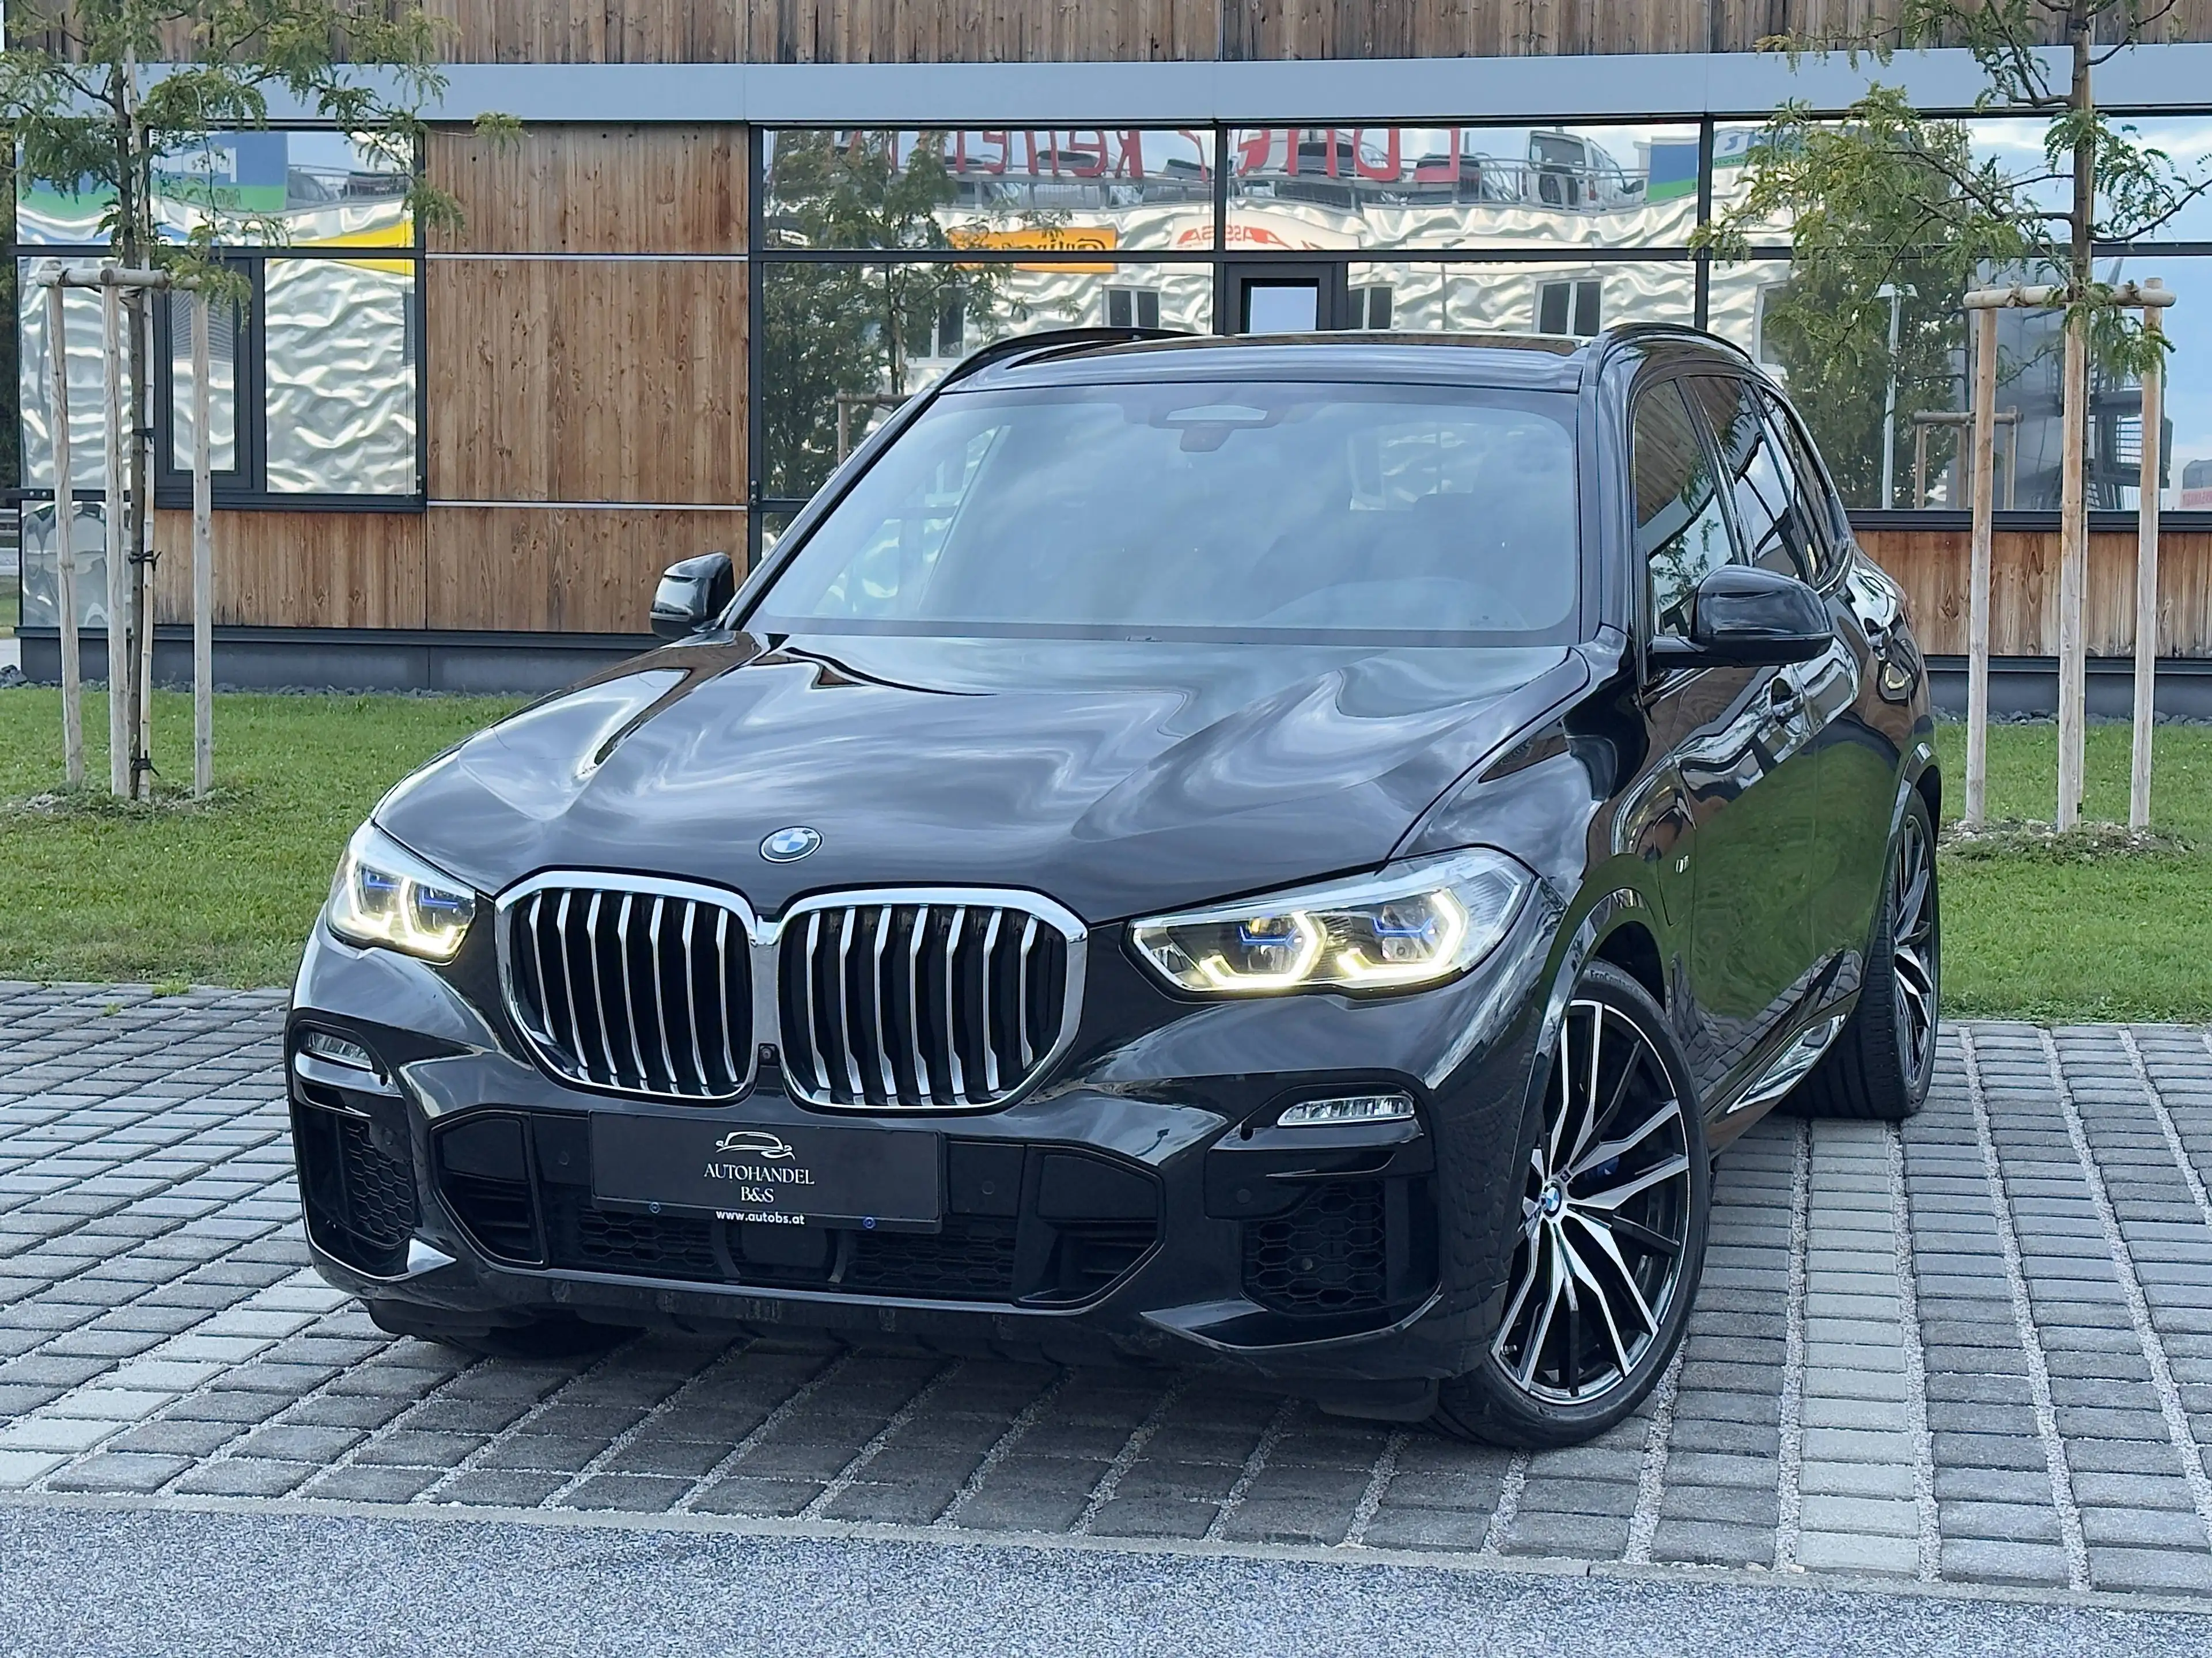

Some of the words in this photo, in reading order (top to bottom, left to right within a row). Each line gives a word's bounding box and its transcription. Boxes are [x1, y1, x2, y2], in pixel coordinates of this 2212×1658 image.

[704, 1163, 815, 1184] AUTOHANDEL
[741, 1186, 774, 1203] B&S
[716, 1211, 805, 1224] www.autobs.at
